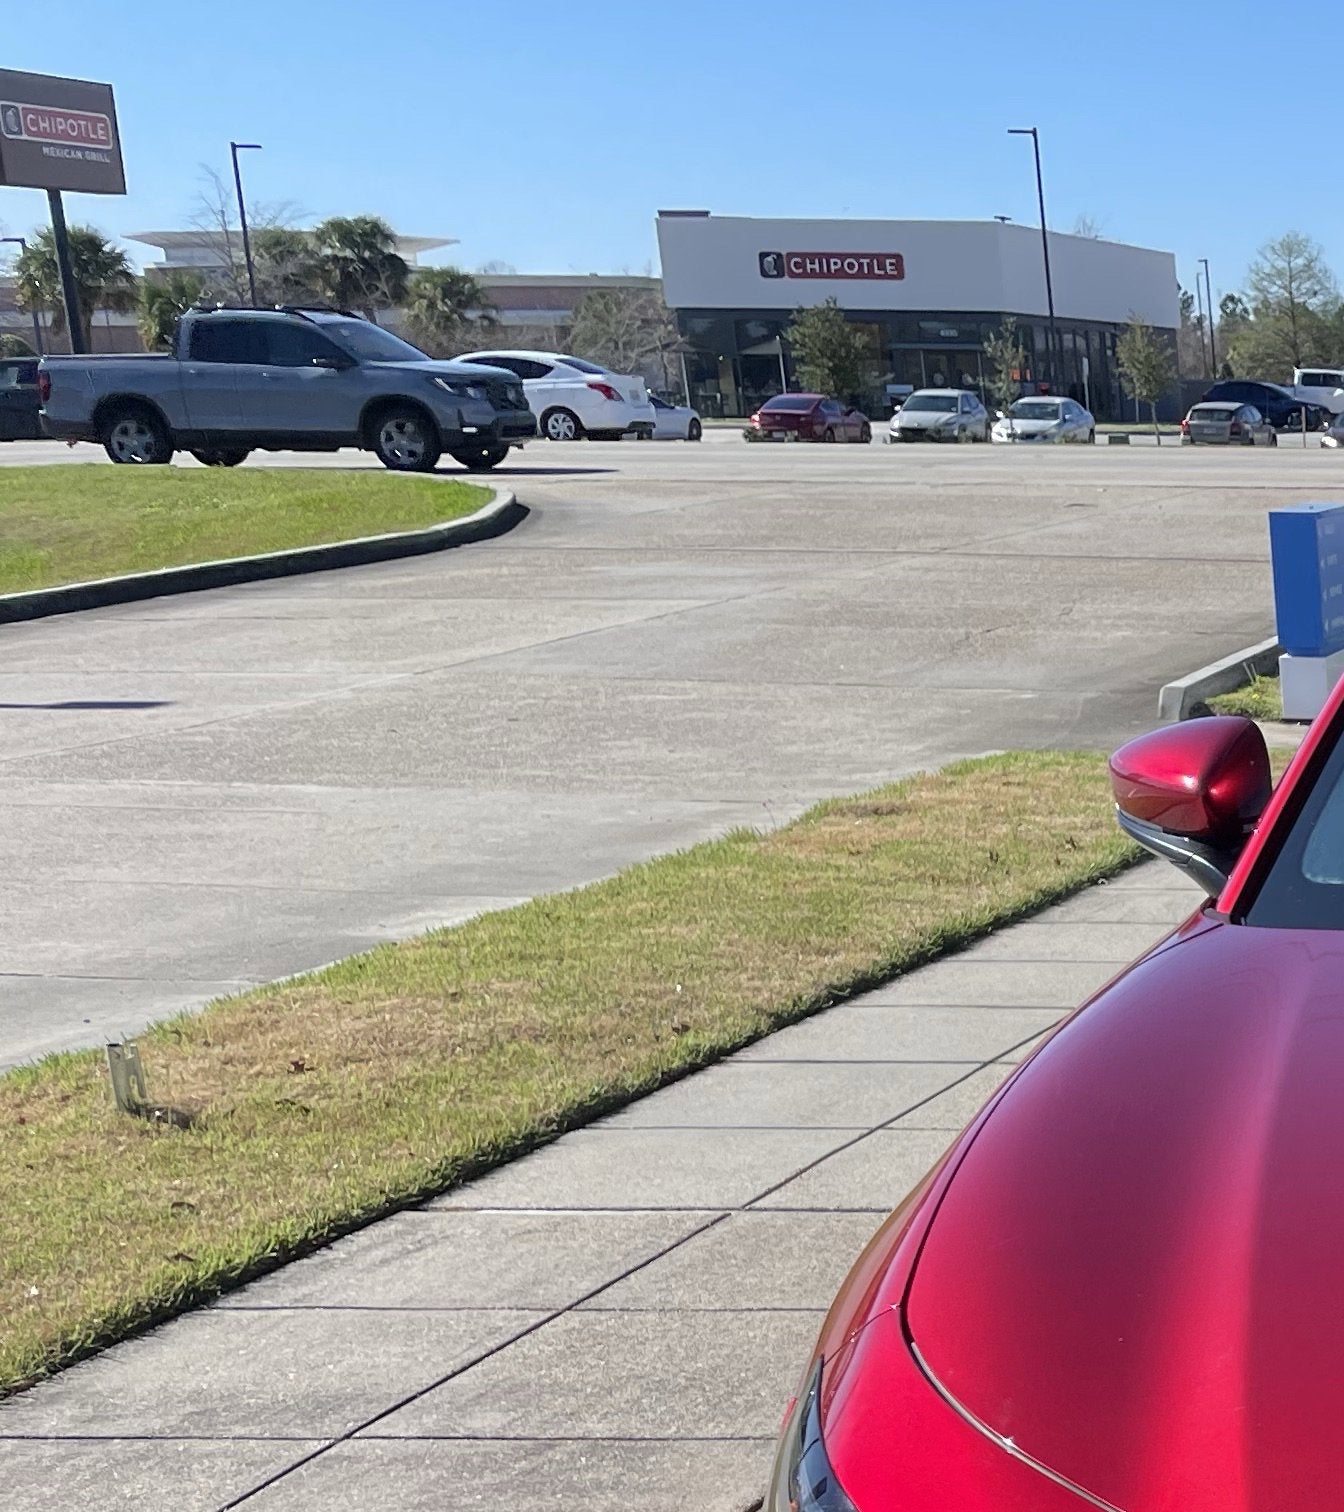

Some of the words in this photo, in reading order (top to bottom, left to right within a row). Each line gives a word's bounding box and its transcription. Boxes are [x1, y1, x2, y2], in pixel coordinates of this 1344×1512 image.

[26, 113, 108, 140] CHIPOTLE
[42, 146, 83, 160] MEXICAN
[790, 257, 898, 275] CHIPOTLE
